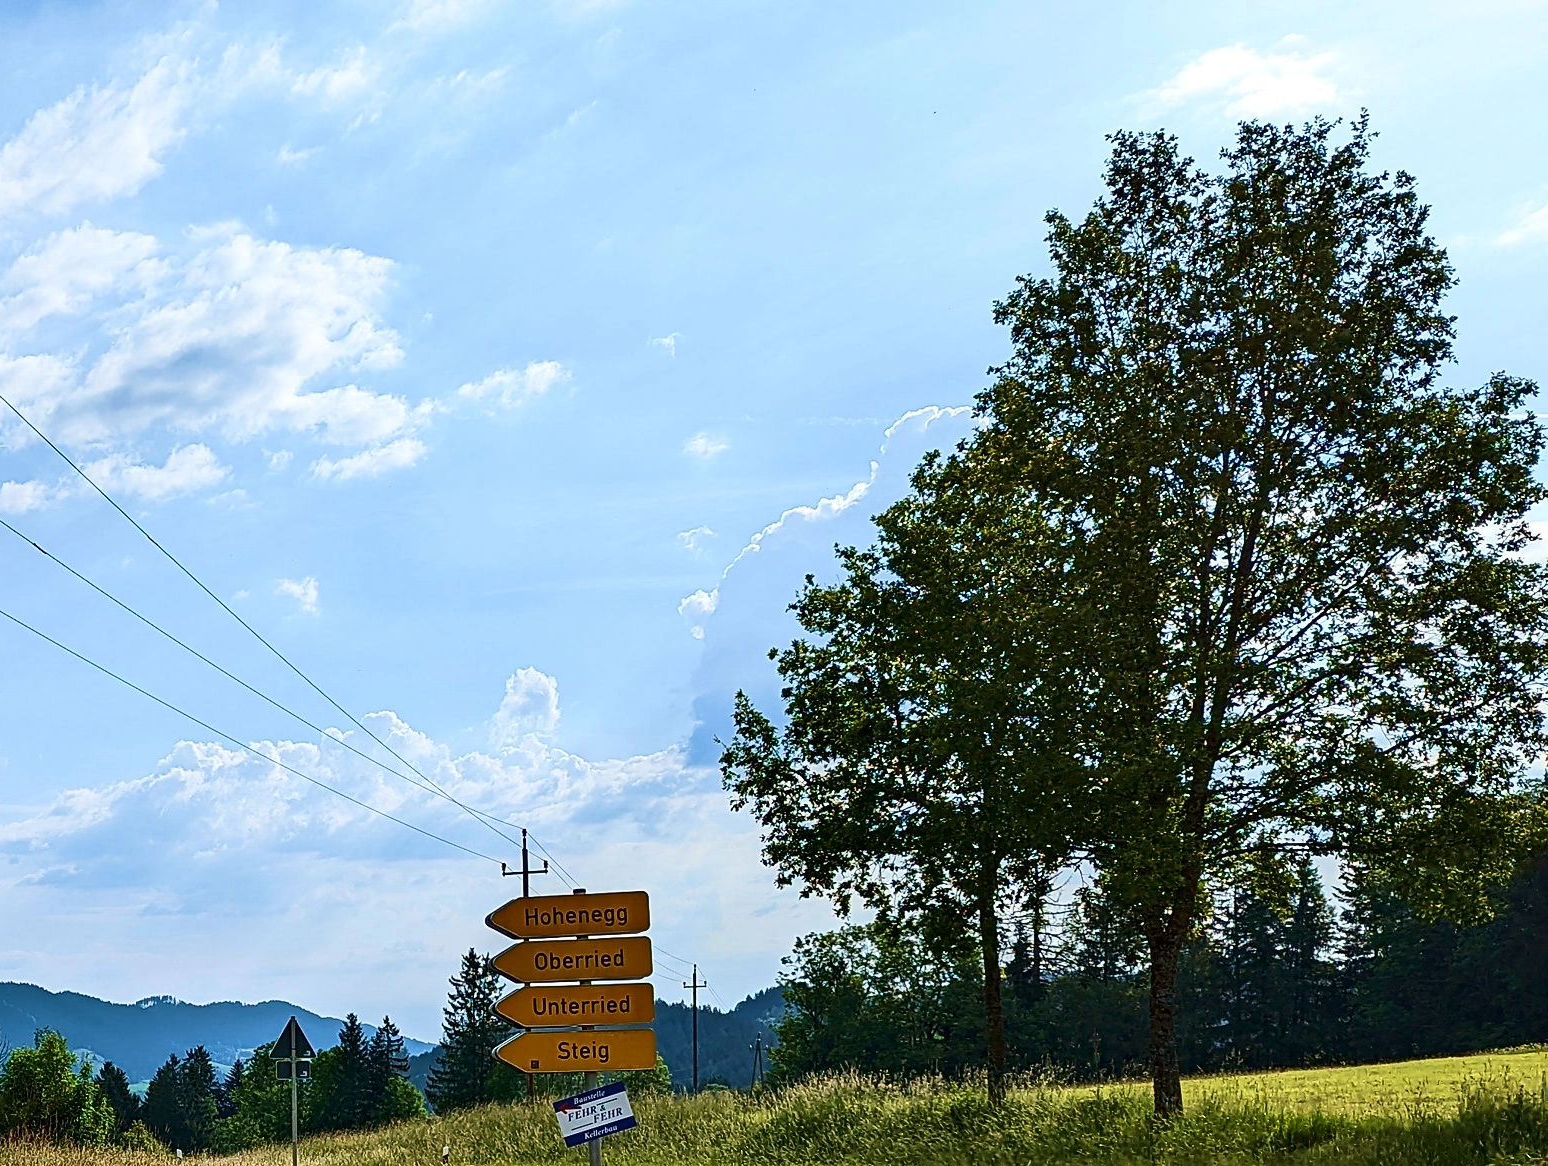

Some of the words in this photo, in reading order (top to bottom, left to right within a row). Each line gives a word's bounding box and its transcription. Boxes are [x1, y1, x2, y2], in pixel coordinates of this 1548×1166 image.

[525, 907, 628, 927] Hohenegg
[534, 949, 624, 970] Oberried
[532, 995, 630, 1015] Unterried
[557, 1041, 609, 1063] Steig
[573, 1089, 606, 1105] Baustelle
[568, 1105, 597, 1122] FEHR
[593, 1107, 623, 1123] FEHR
[584, 1125, 618, 1140] Kellerbau
